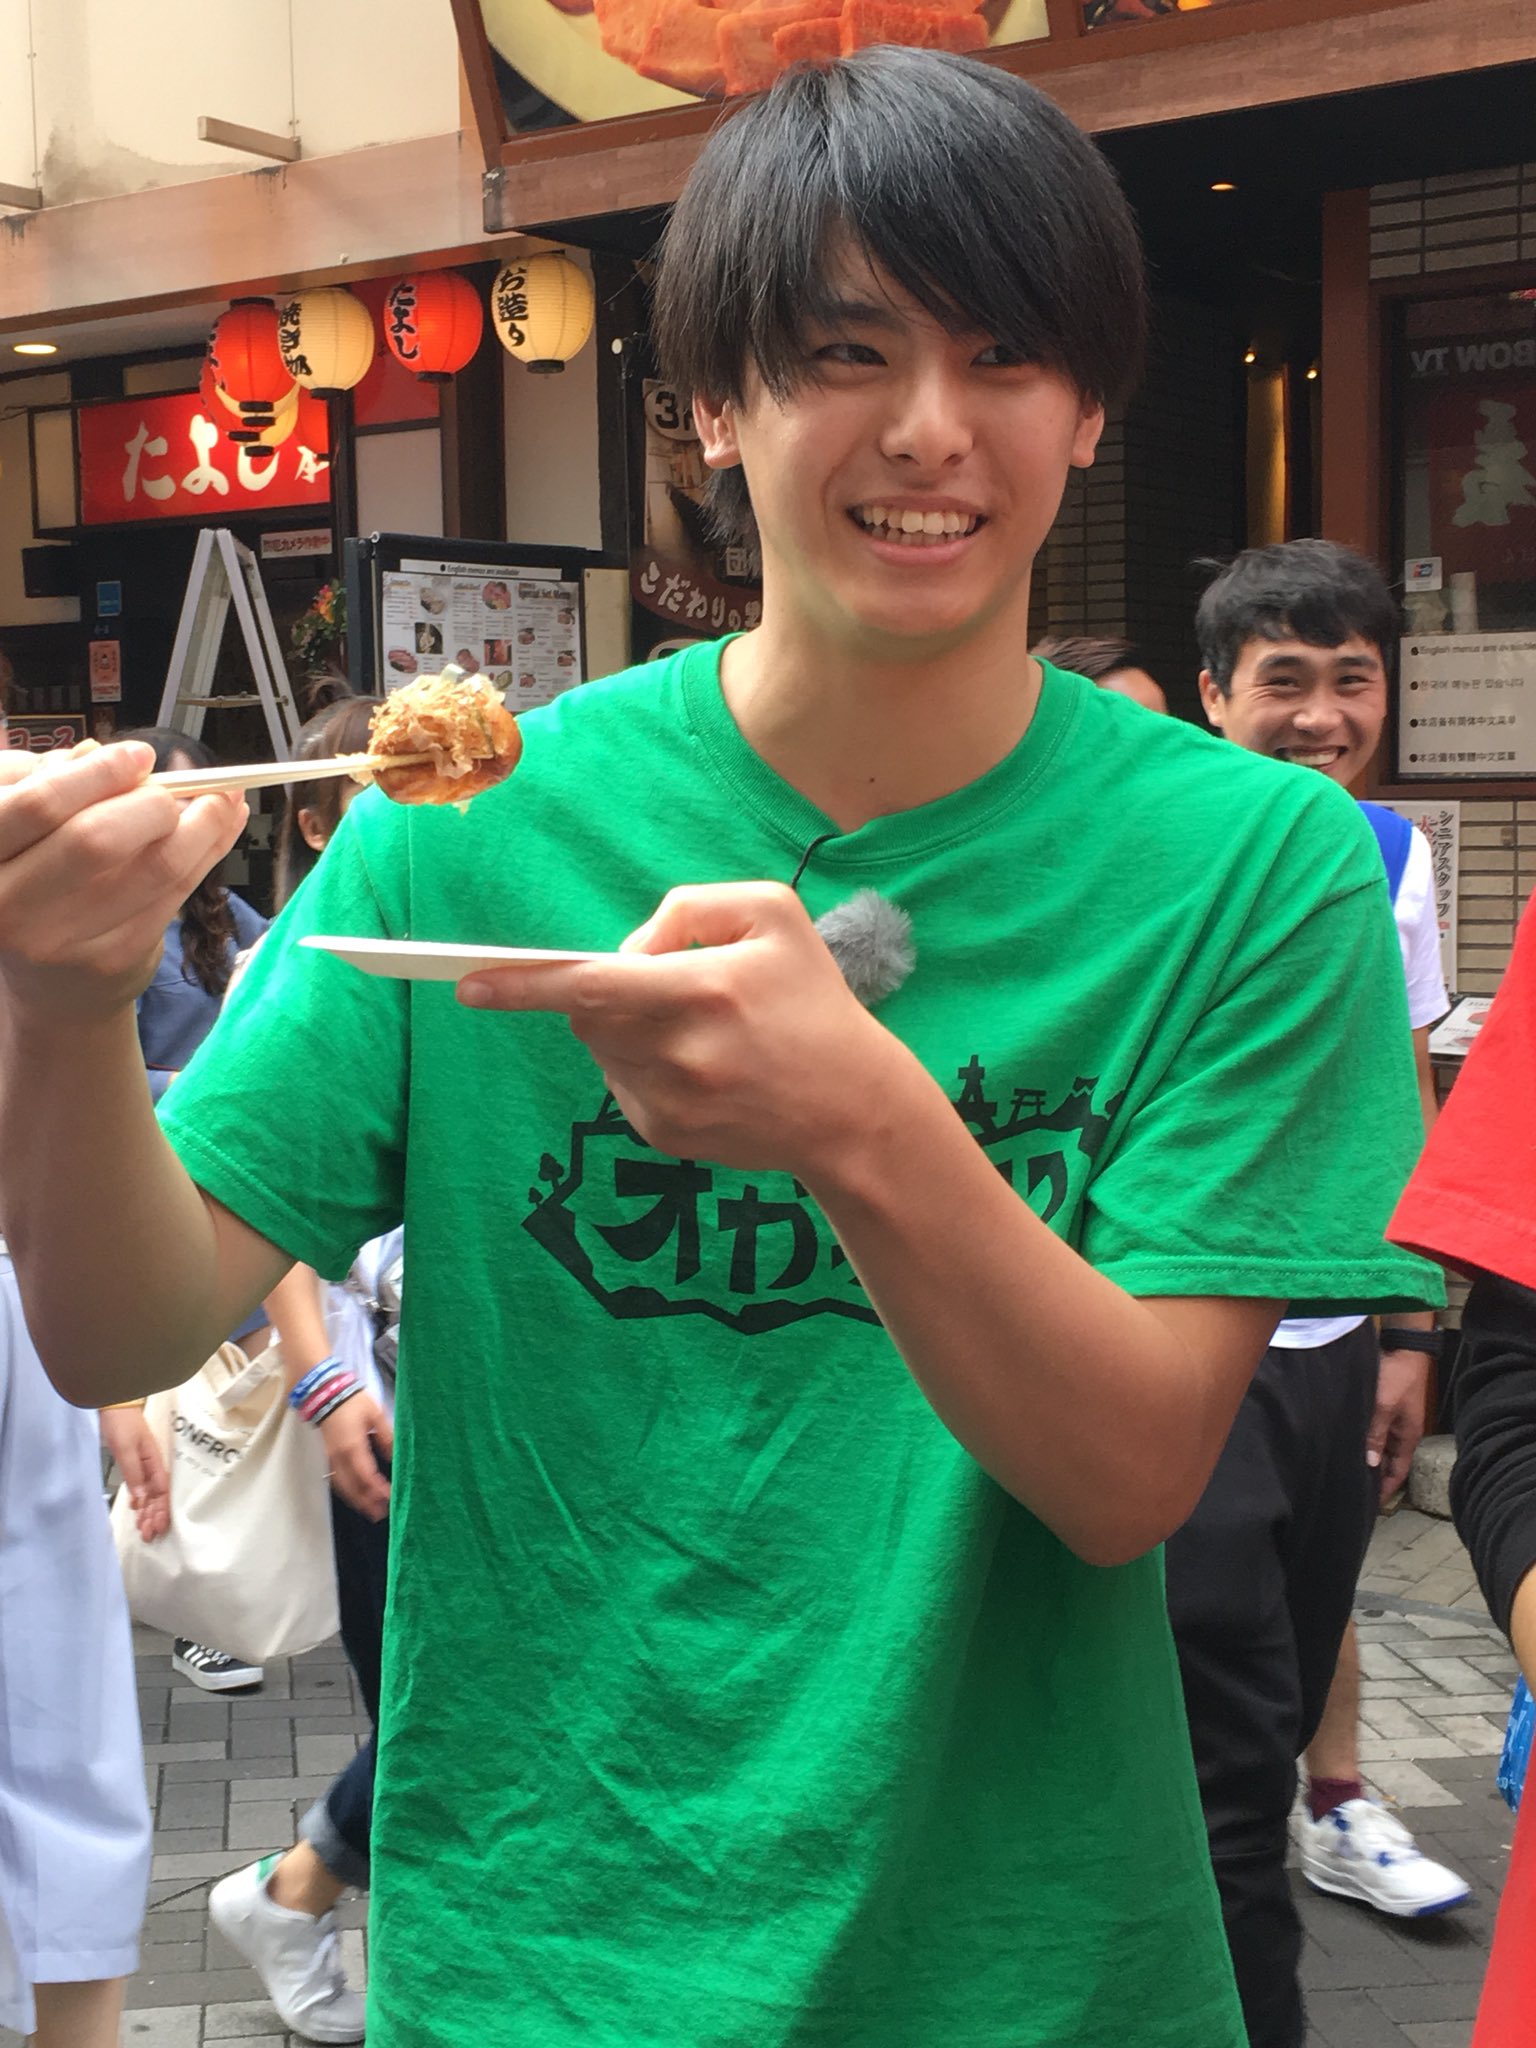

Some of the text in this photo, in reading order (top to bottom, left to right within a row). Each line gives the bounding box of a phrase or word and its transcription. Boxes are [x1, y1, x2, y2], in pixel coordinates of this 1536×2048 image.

[389, 283, 419, 359] たよし
[498, 267, 528, 346] お造り
[123, 414, 280, 502] たよし
[1437, 810, 1454, 917] シニアスタッフ
